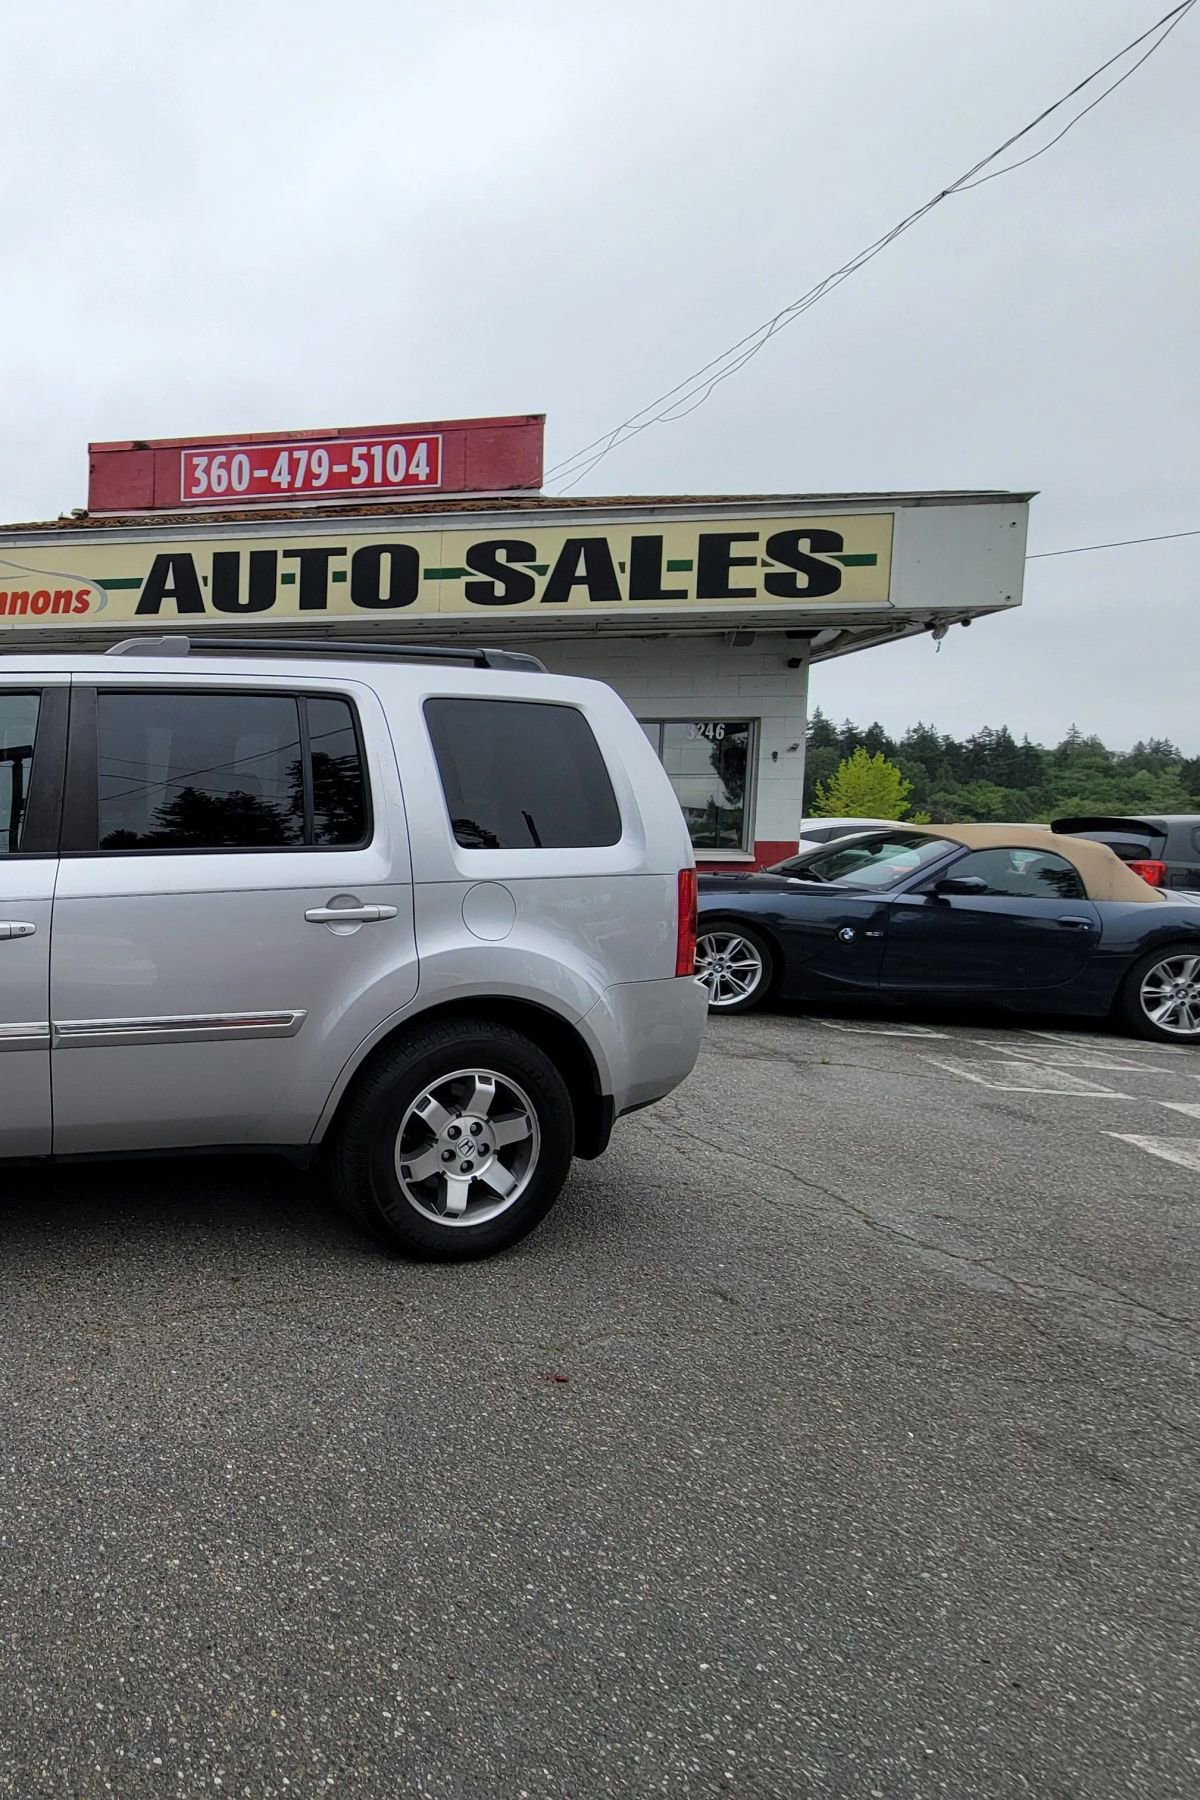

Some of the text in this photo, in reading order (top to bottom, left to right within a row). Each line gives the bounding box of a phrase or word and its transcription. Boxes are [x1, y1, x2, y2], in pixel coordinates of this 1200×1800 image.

[191, 442, 430, 494] 360-479-5104
[134, 543, 420, 615] AUTO
[464, 528, 844, 606] SALES
